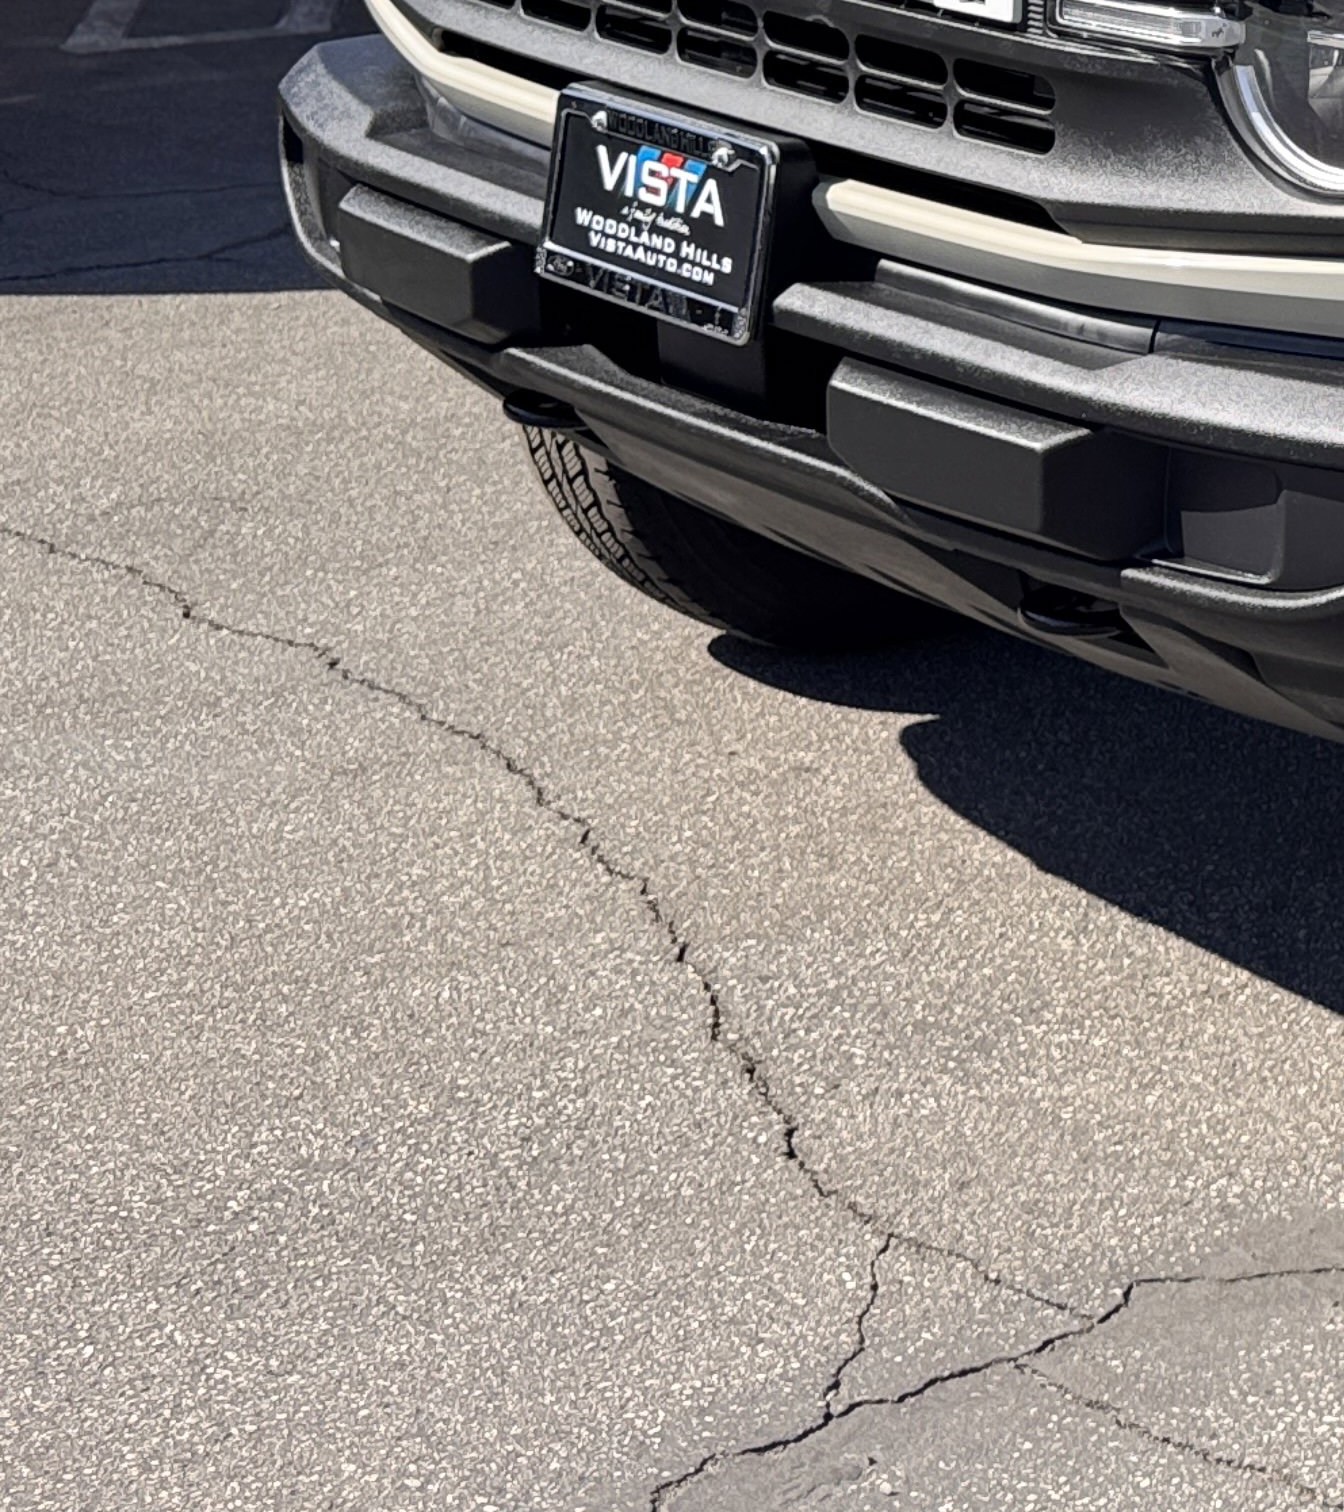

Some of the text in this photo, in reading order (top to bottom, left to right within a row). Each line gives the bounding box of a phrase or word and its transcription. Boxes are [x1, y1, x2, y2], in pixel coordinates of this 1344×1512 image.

[595, 143, 726, 228] VISTA
[575, 206, 733, 275] WOODLAND HILLS
